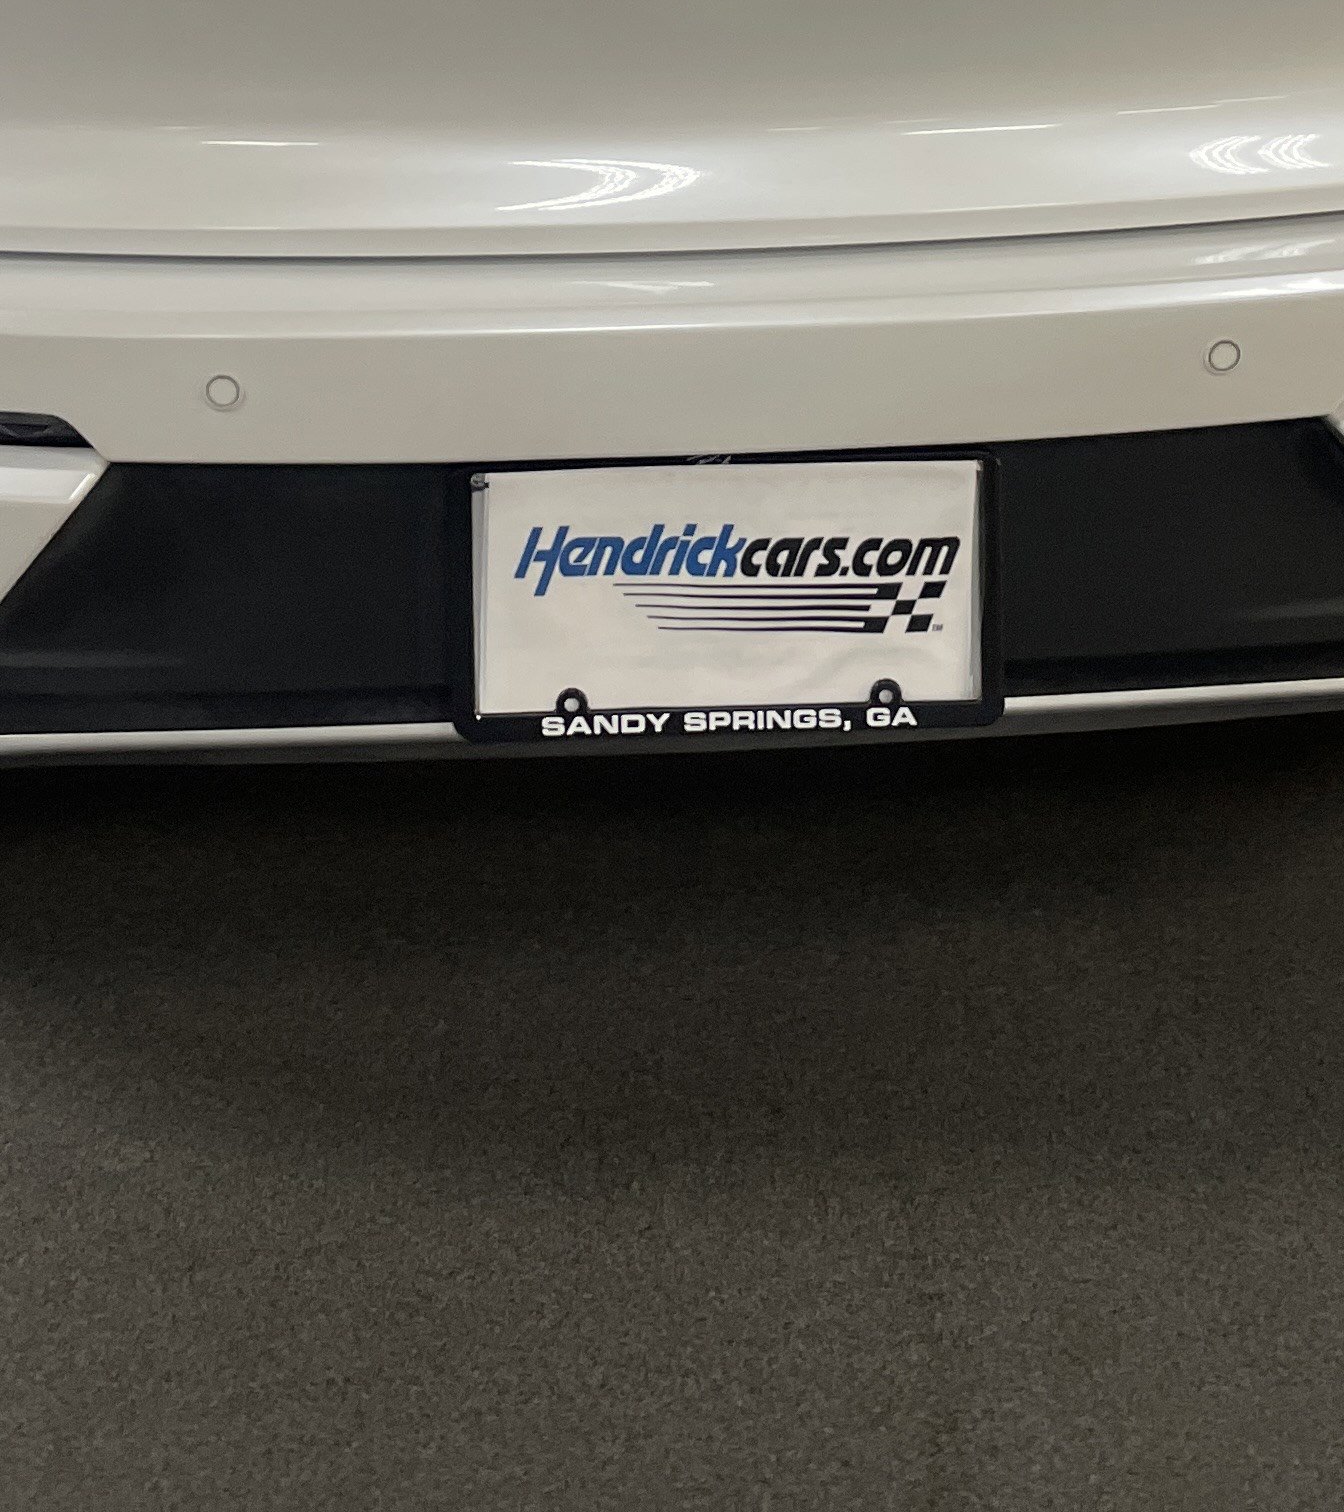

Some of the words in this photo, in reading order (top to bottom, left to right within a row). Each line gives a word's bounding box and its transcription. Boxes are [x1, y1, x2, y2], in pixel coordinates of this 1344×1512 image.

[514, 523, 961, 596] Hendrickcars.com
[541, 713, 670, 736] SANDY
[683, 709, 852, 732] SPRINGS,
[865, 706, 918, 728] GA
